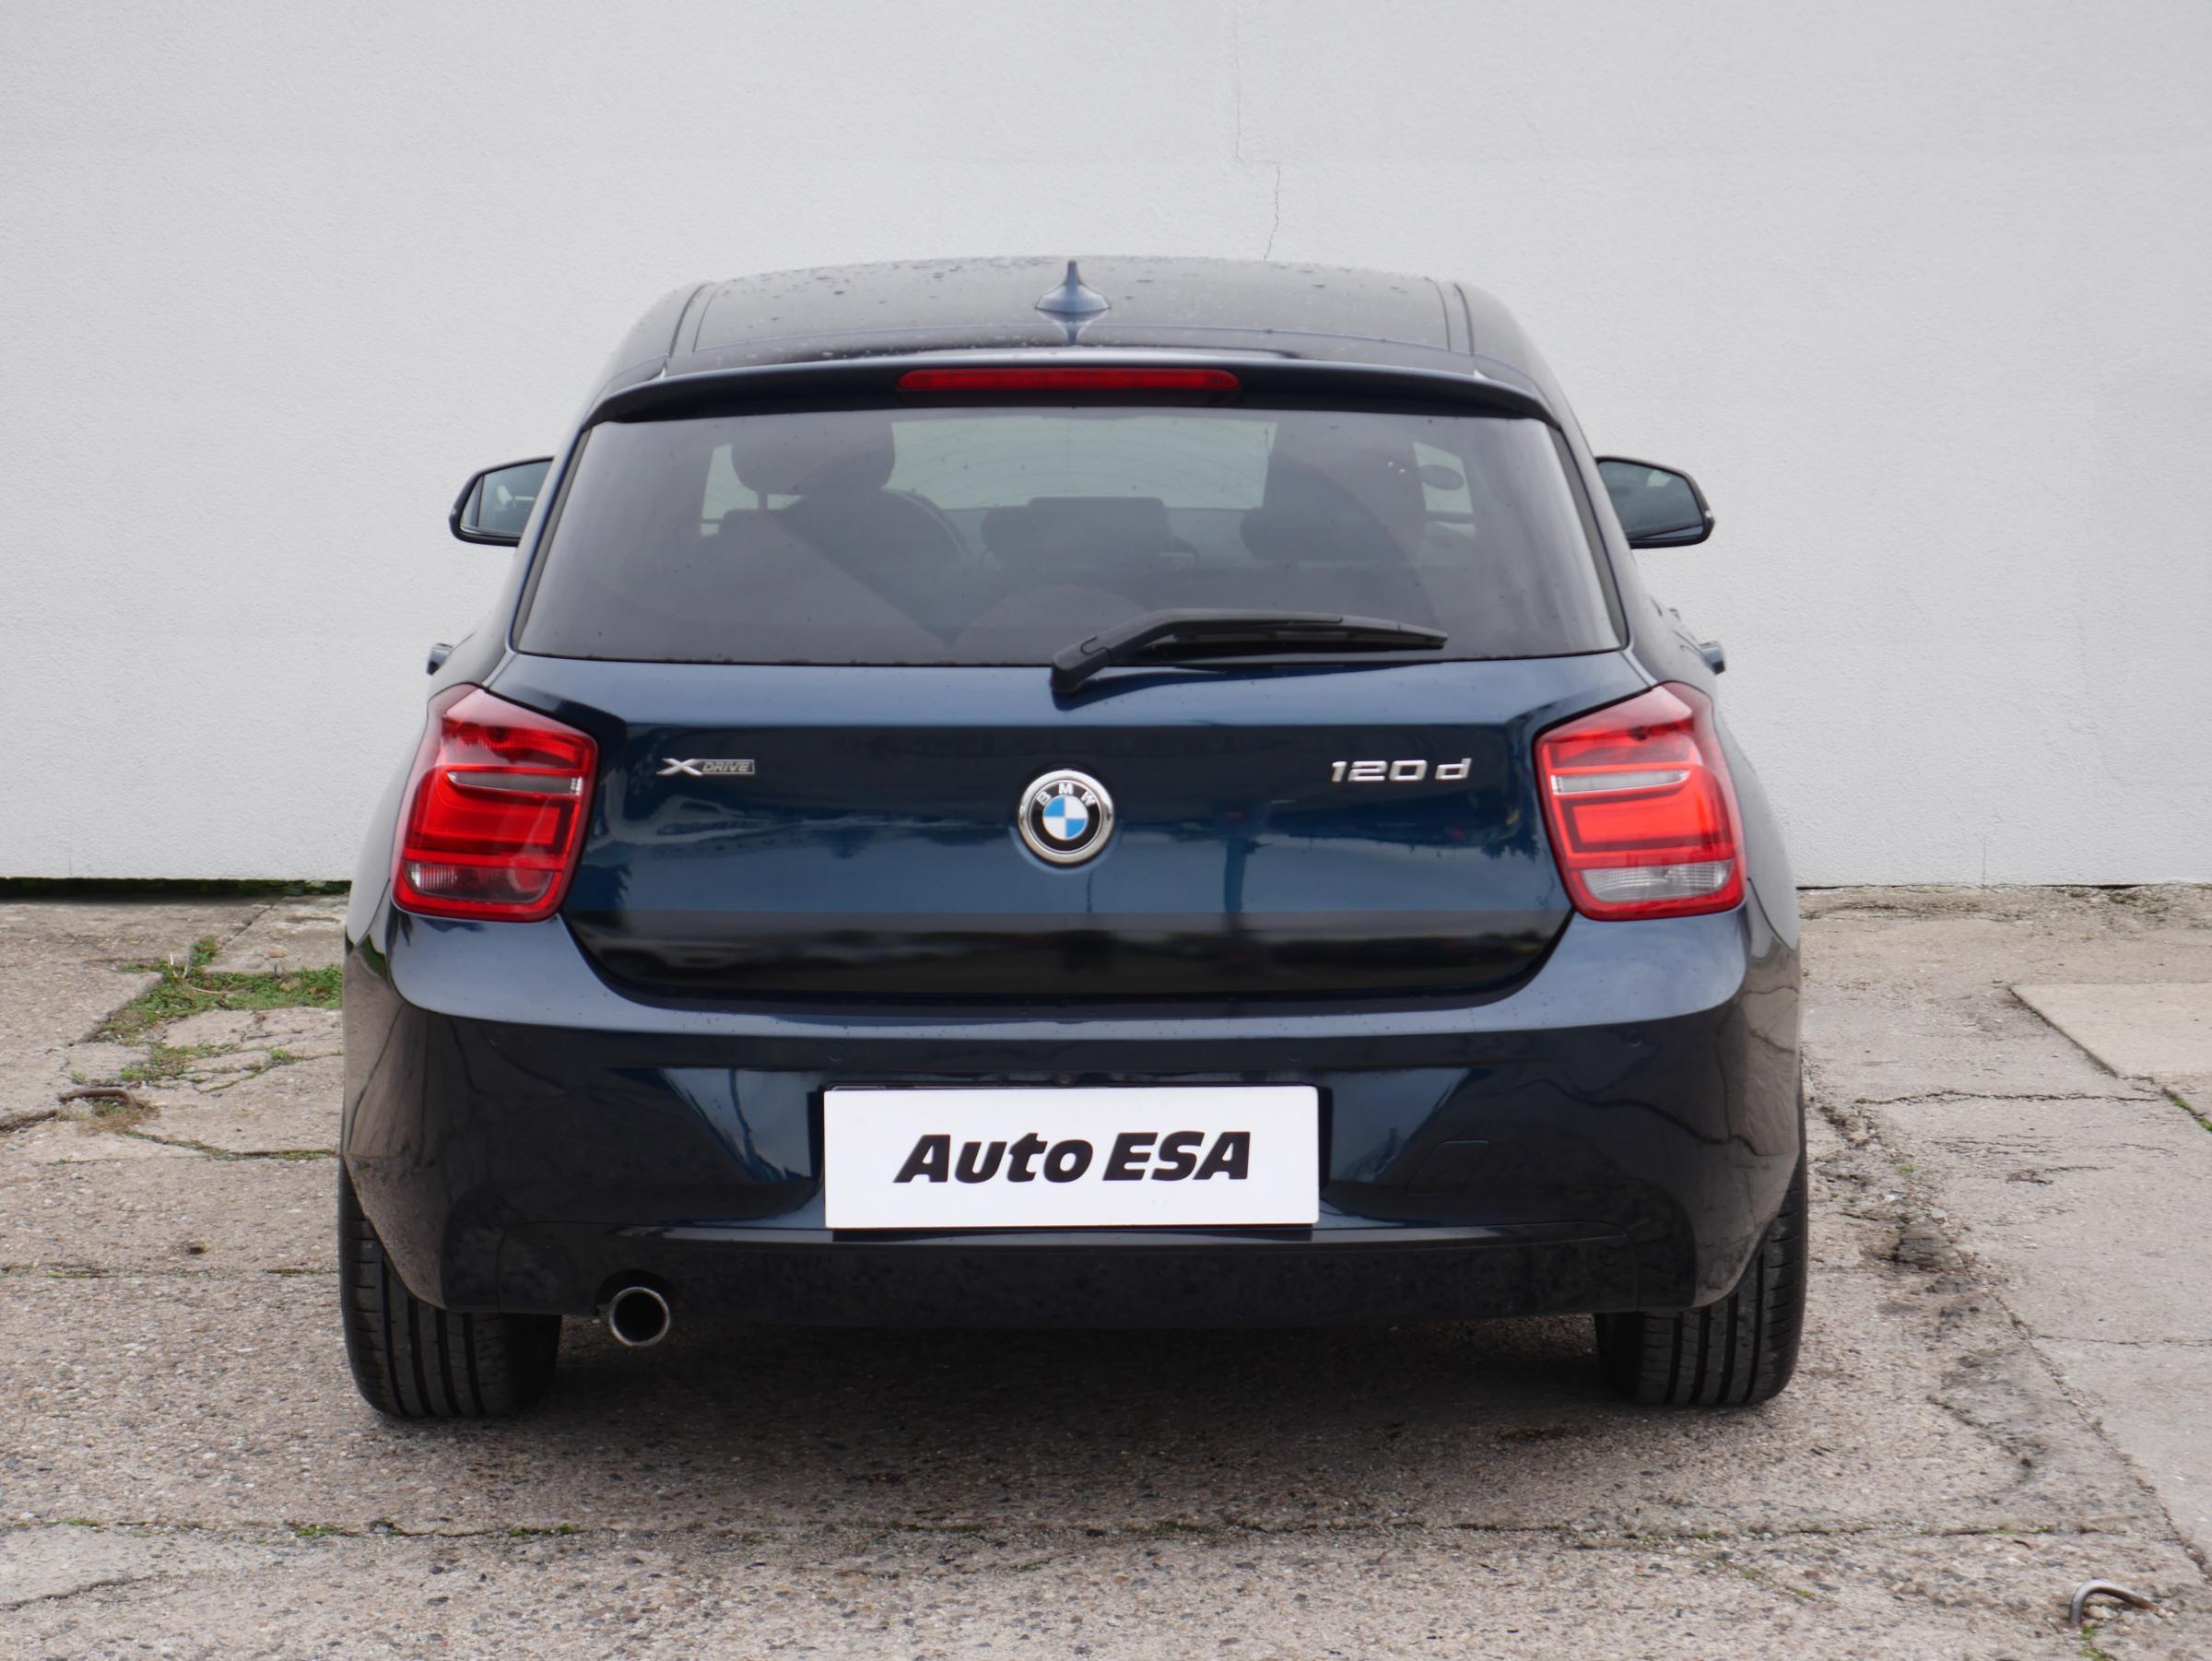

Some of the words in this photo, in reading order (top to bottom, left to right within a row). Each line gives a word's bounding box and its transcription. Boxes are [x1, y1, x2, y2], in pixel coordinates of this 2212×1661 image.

[1036, 783, 1096, 807] BMW
[893, 1133, 1094, 1184] Auto
[1102, 1131, 1251, 1181] ESA
